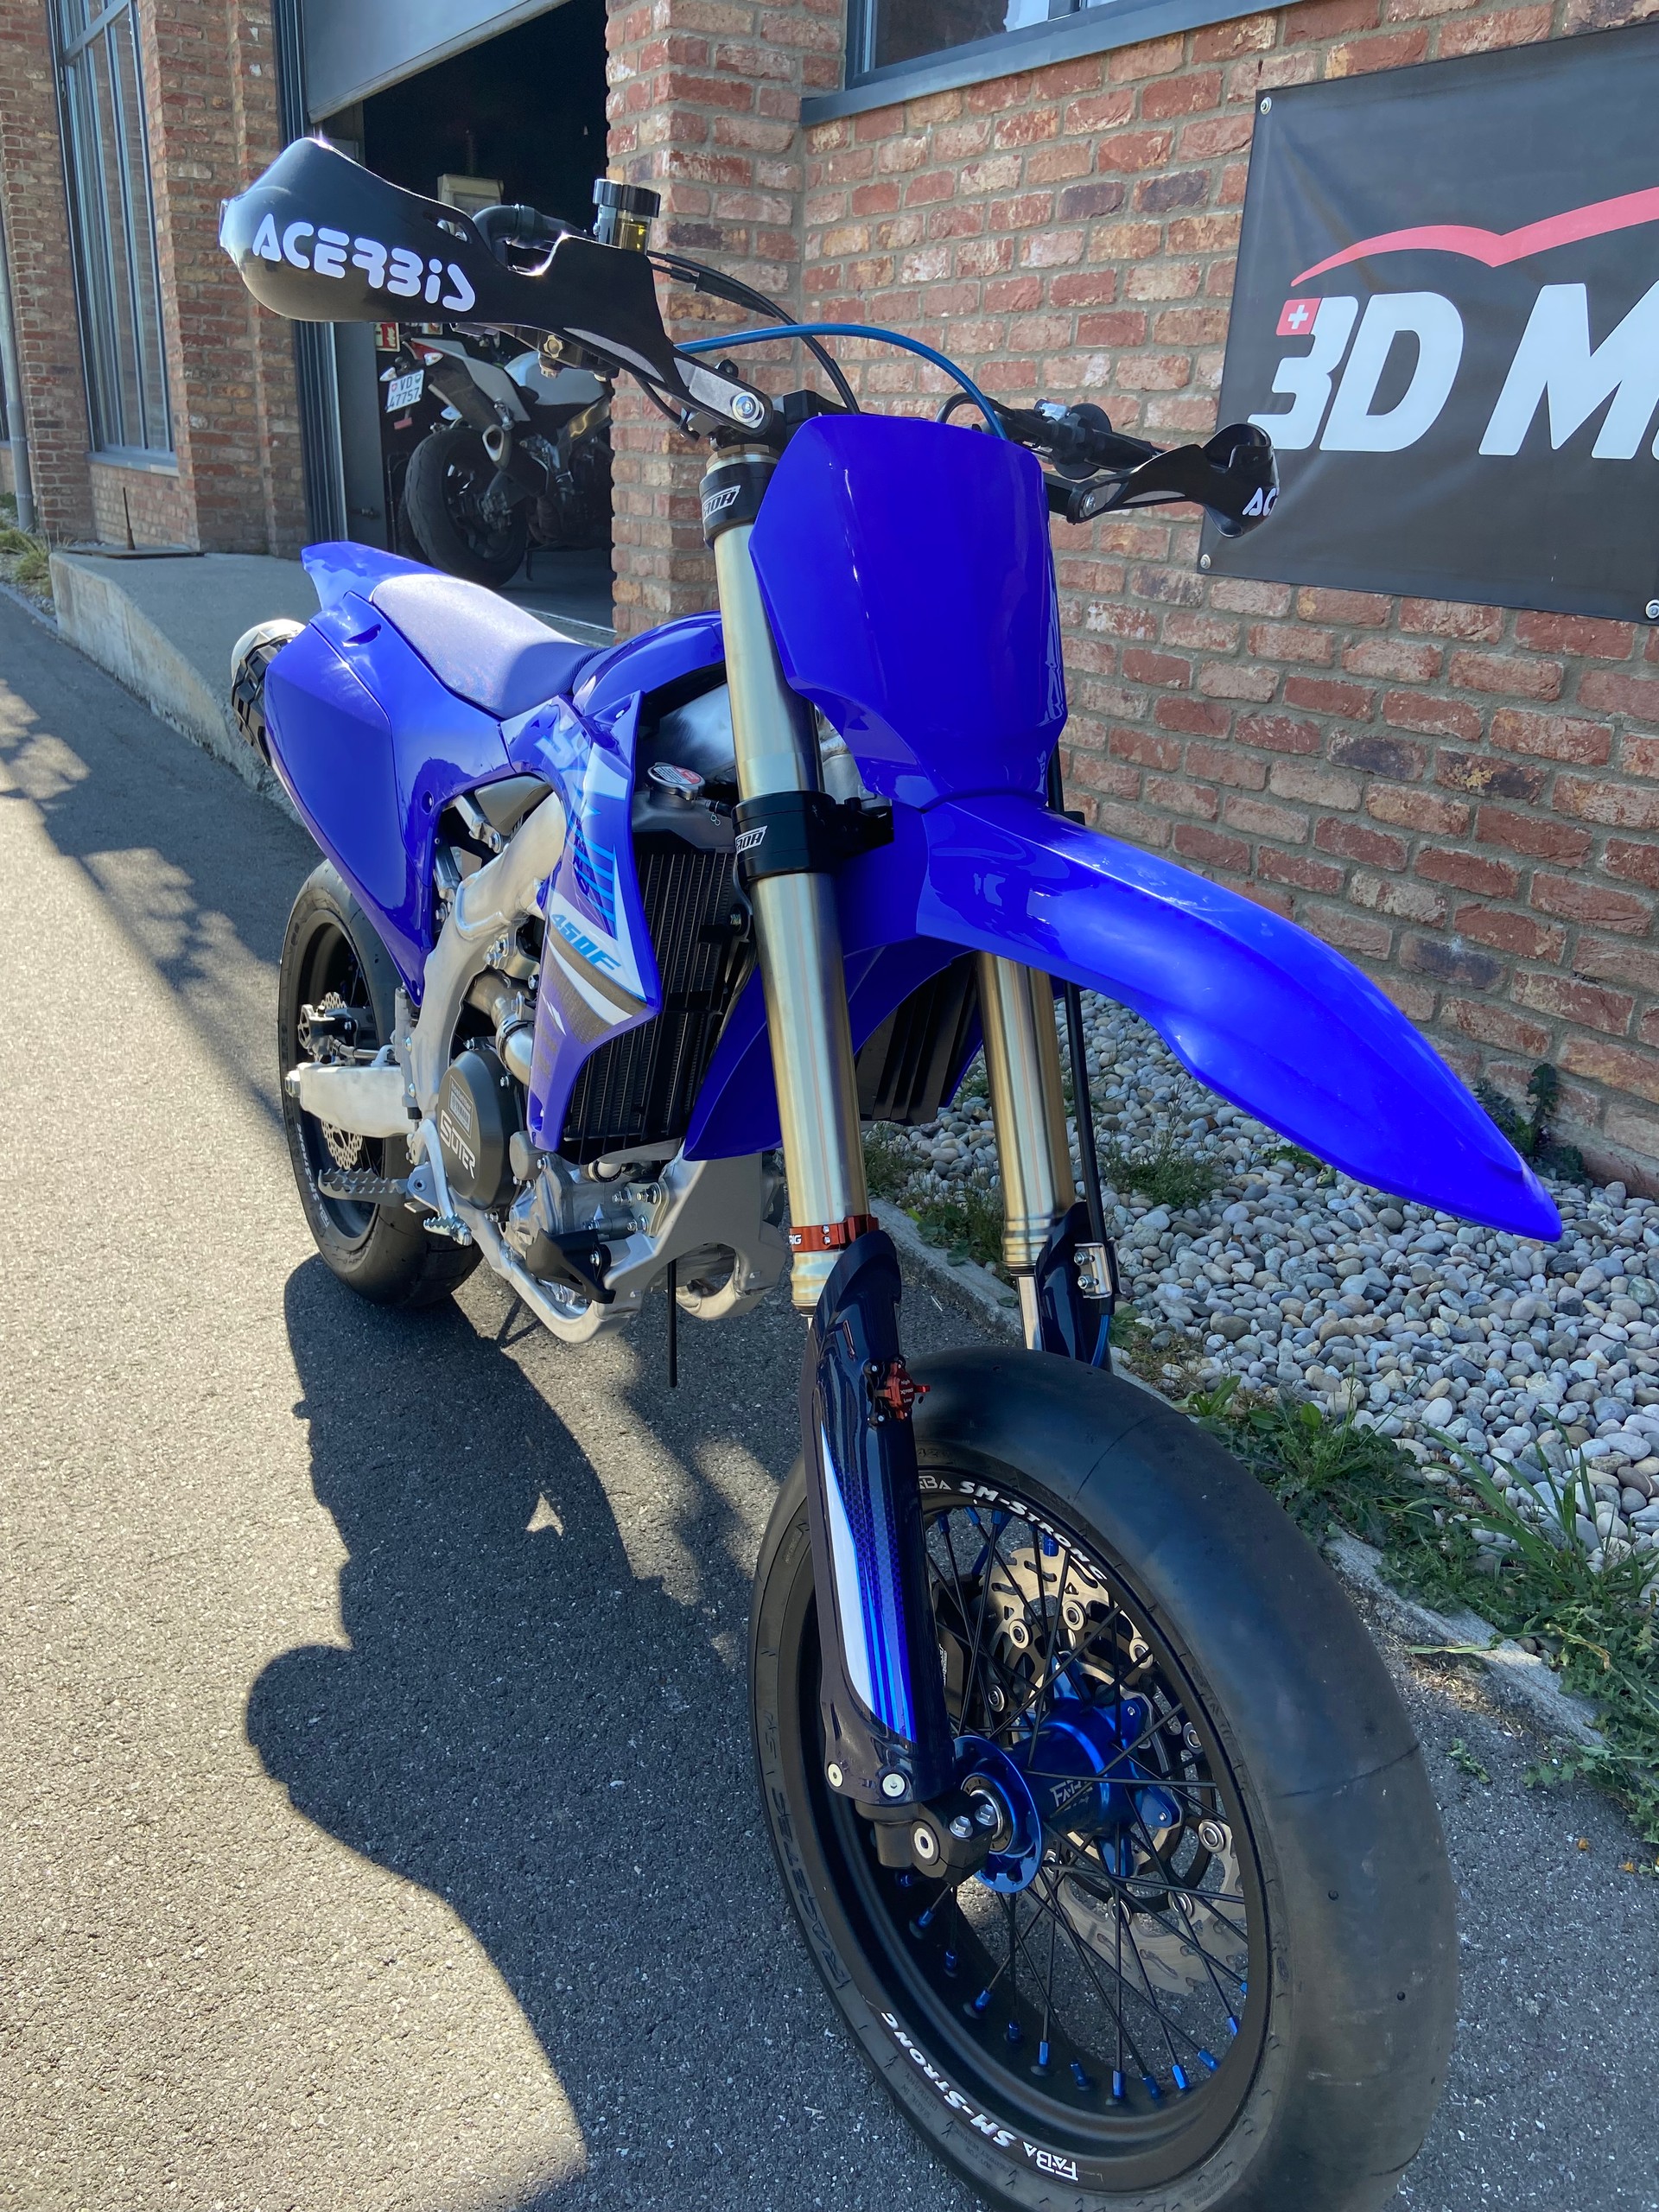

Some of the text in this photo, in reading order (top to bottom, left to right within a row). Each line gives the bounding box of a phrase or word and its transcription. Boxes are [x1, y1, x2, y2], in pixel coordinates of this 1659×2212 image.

[251, 213, 476, 312] ACERBIS
[389, 387, 420, 407] 47757
[400, 376, 413, 391] VD
[1478, 279, 1659, 460] M
[550, 913, 622, 970] 450F
[440, 1109, 476, 1179] SUTER
